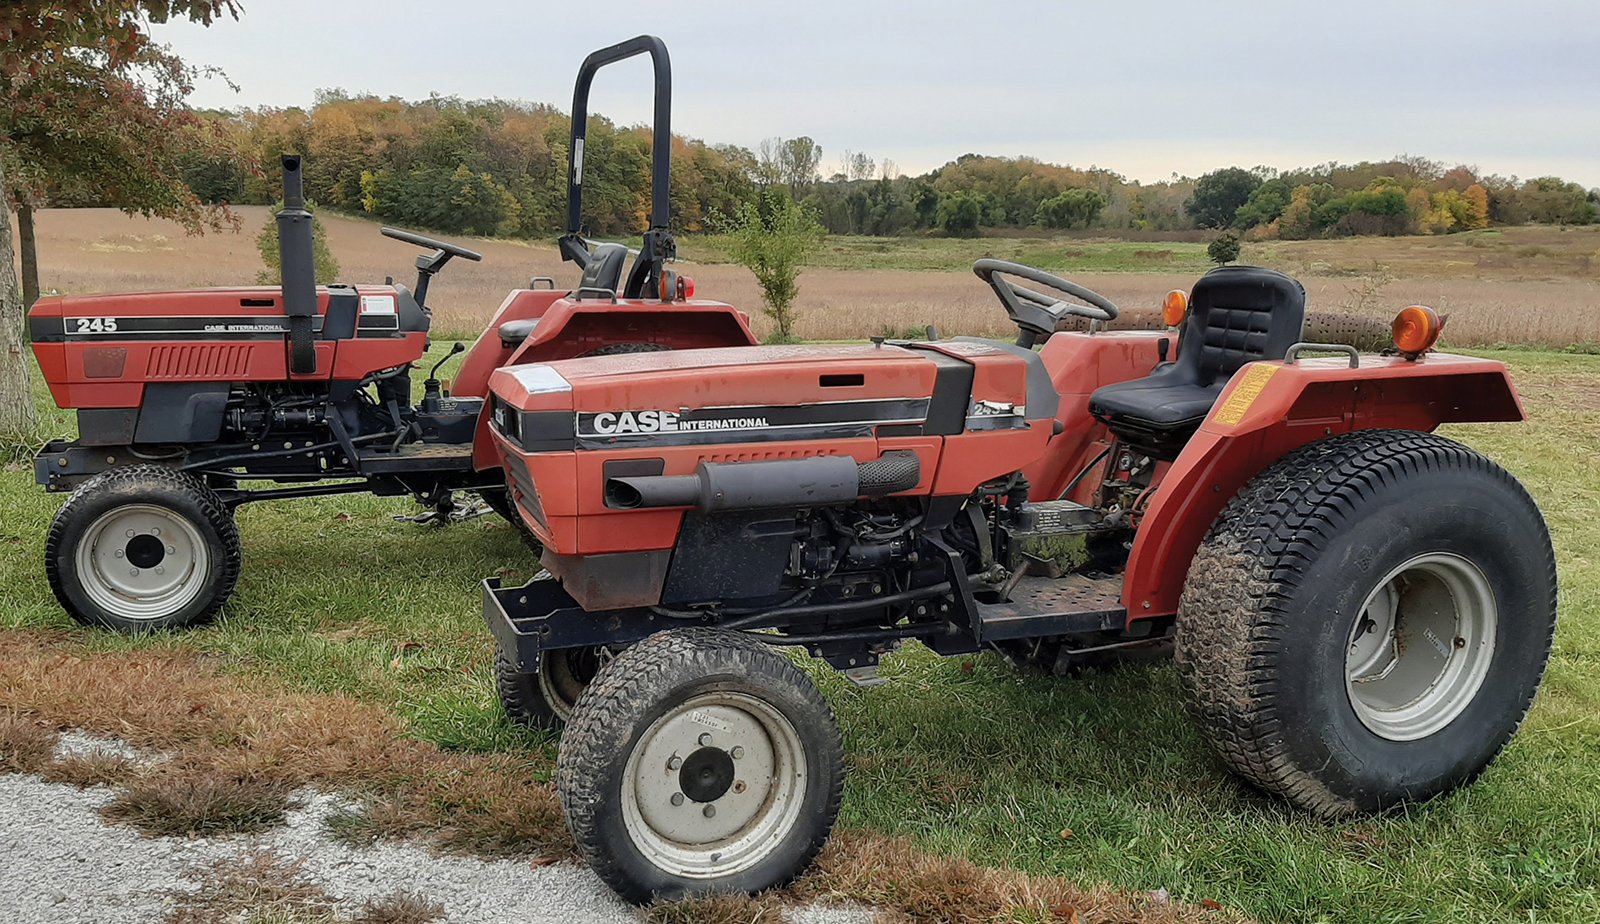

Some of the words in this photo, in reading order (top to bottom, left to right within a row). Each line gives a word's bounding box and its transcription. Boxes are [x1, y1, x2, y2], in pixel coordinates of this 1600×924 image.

[77, 318, 117, 332] 245
[593, 411, 679, 434] CASE
[679, 418, 769, 430] INTERNATIONAL
